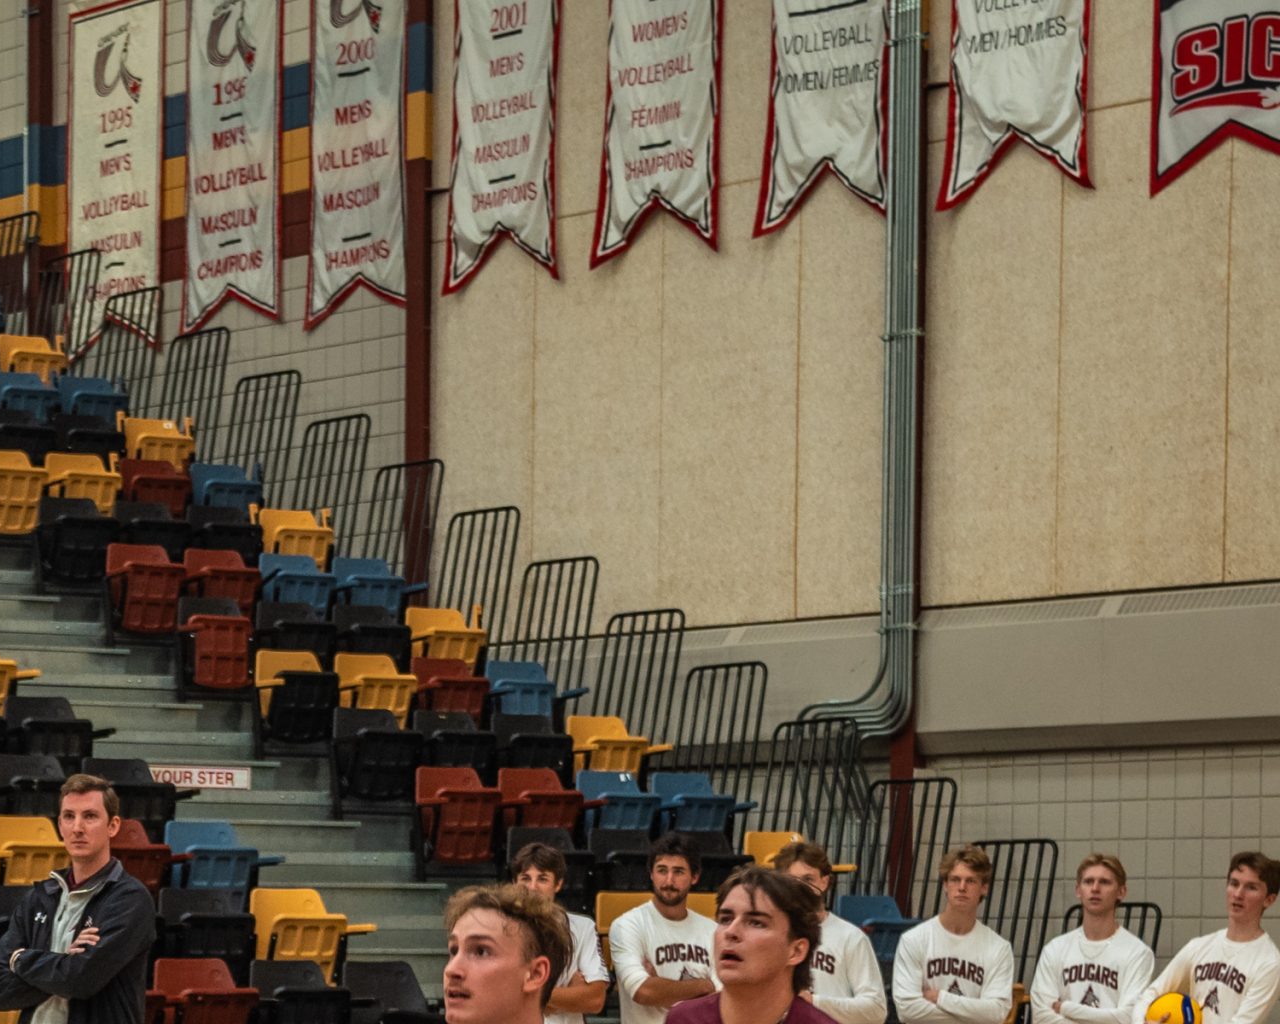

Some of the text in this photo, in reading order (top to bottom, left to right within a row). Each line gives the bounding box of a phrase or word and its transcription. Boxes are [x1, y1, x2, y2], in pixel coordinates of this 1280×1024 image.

[489, 1, 528, 33] 2001
[782, 23, 872, 56] VOLLEYBALL
[617, 53, 694, 88] VOLLEYBALL
[780, 58, 880, 94] OMEN/FEMMES
[99, 105, 133, 133] 1995
[152, 769, 193, 785] YOUR
[655, 943, 710, 967] COUGARS
[926, 957, 985, 987] COUGARS
[1062, 963, 1119, 991] COUGARS
[1194, 961, 1247, 995] COUGARS
